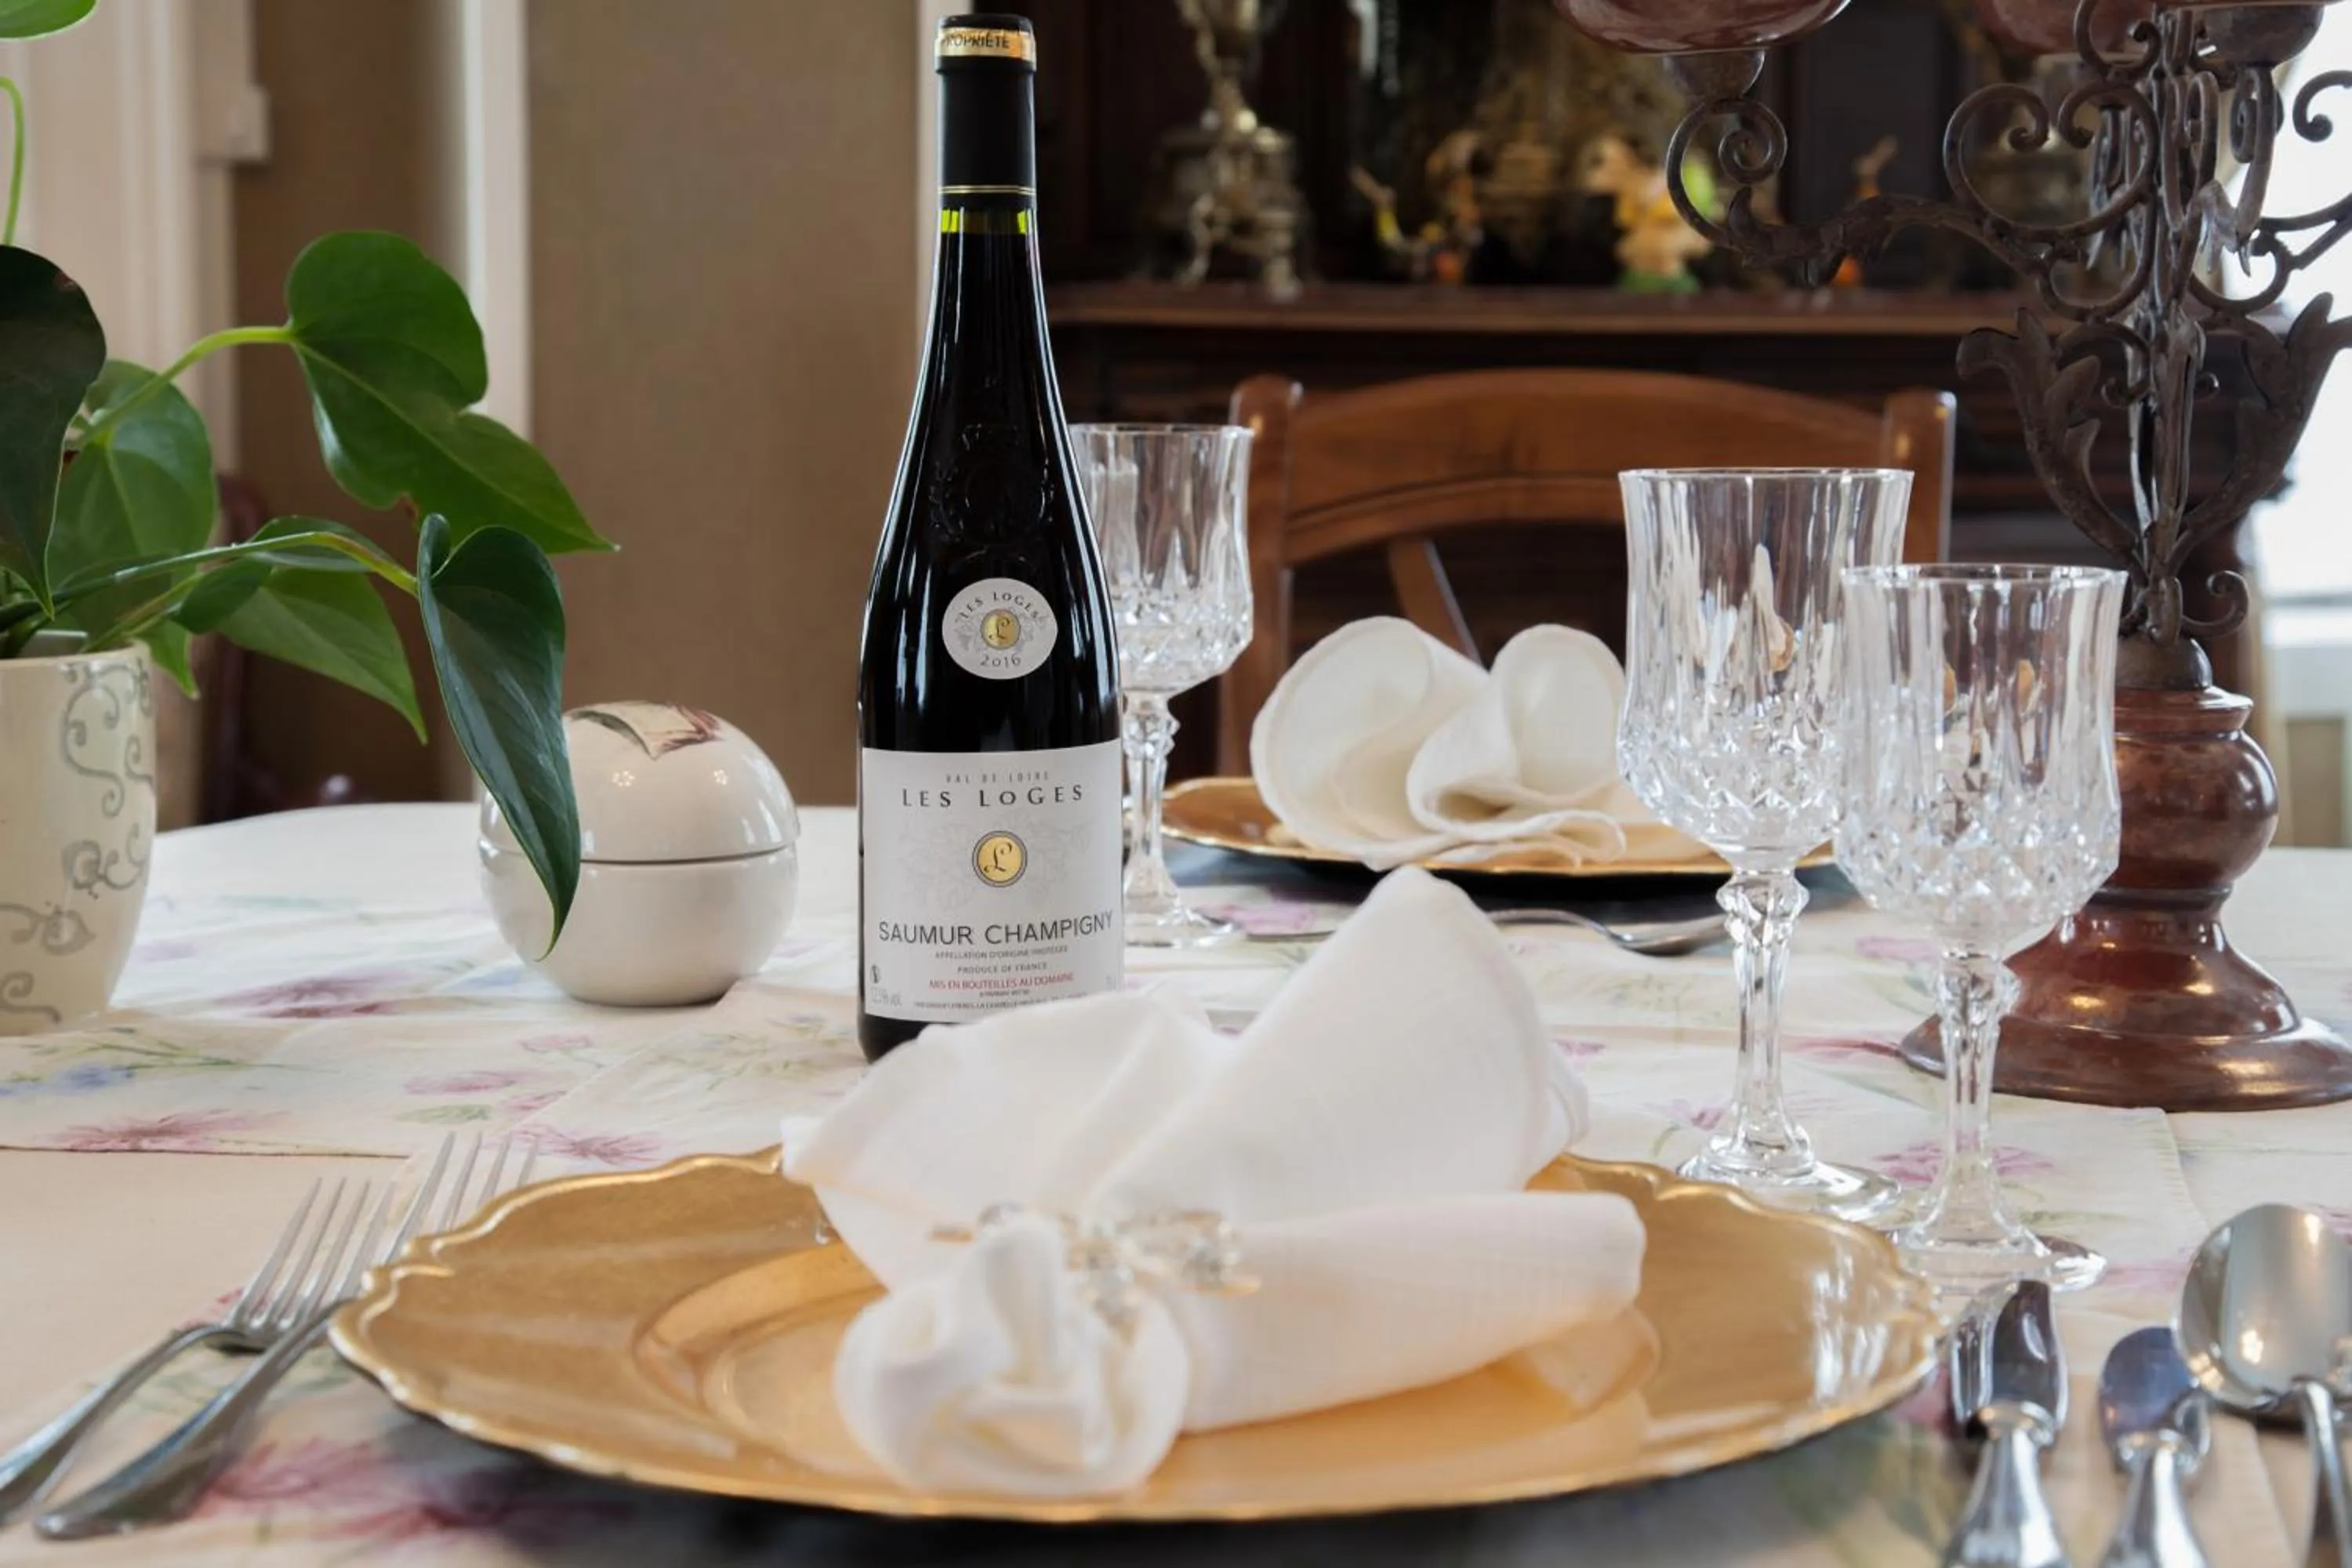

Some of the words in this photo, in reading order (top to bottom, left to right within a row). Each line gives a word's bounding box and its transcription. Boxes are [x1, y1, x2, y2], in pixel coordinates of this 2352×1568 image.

[959, 597, 983, 619] LES
[993, 591, 1040, 619] LOGES
[981, 652, 1022, 668] 2016
[902, 788, 951, 808] LES
[979, 784, 1082, 808] LOGES
[878, 920, 974, 945] SAUMUR
[984, 909, 1113, 945] CHAMPIGNY
